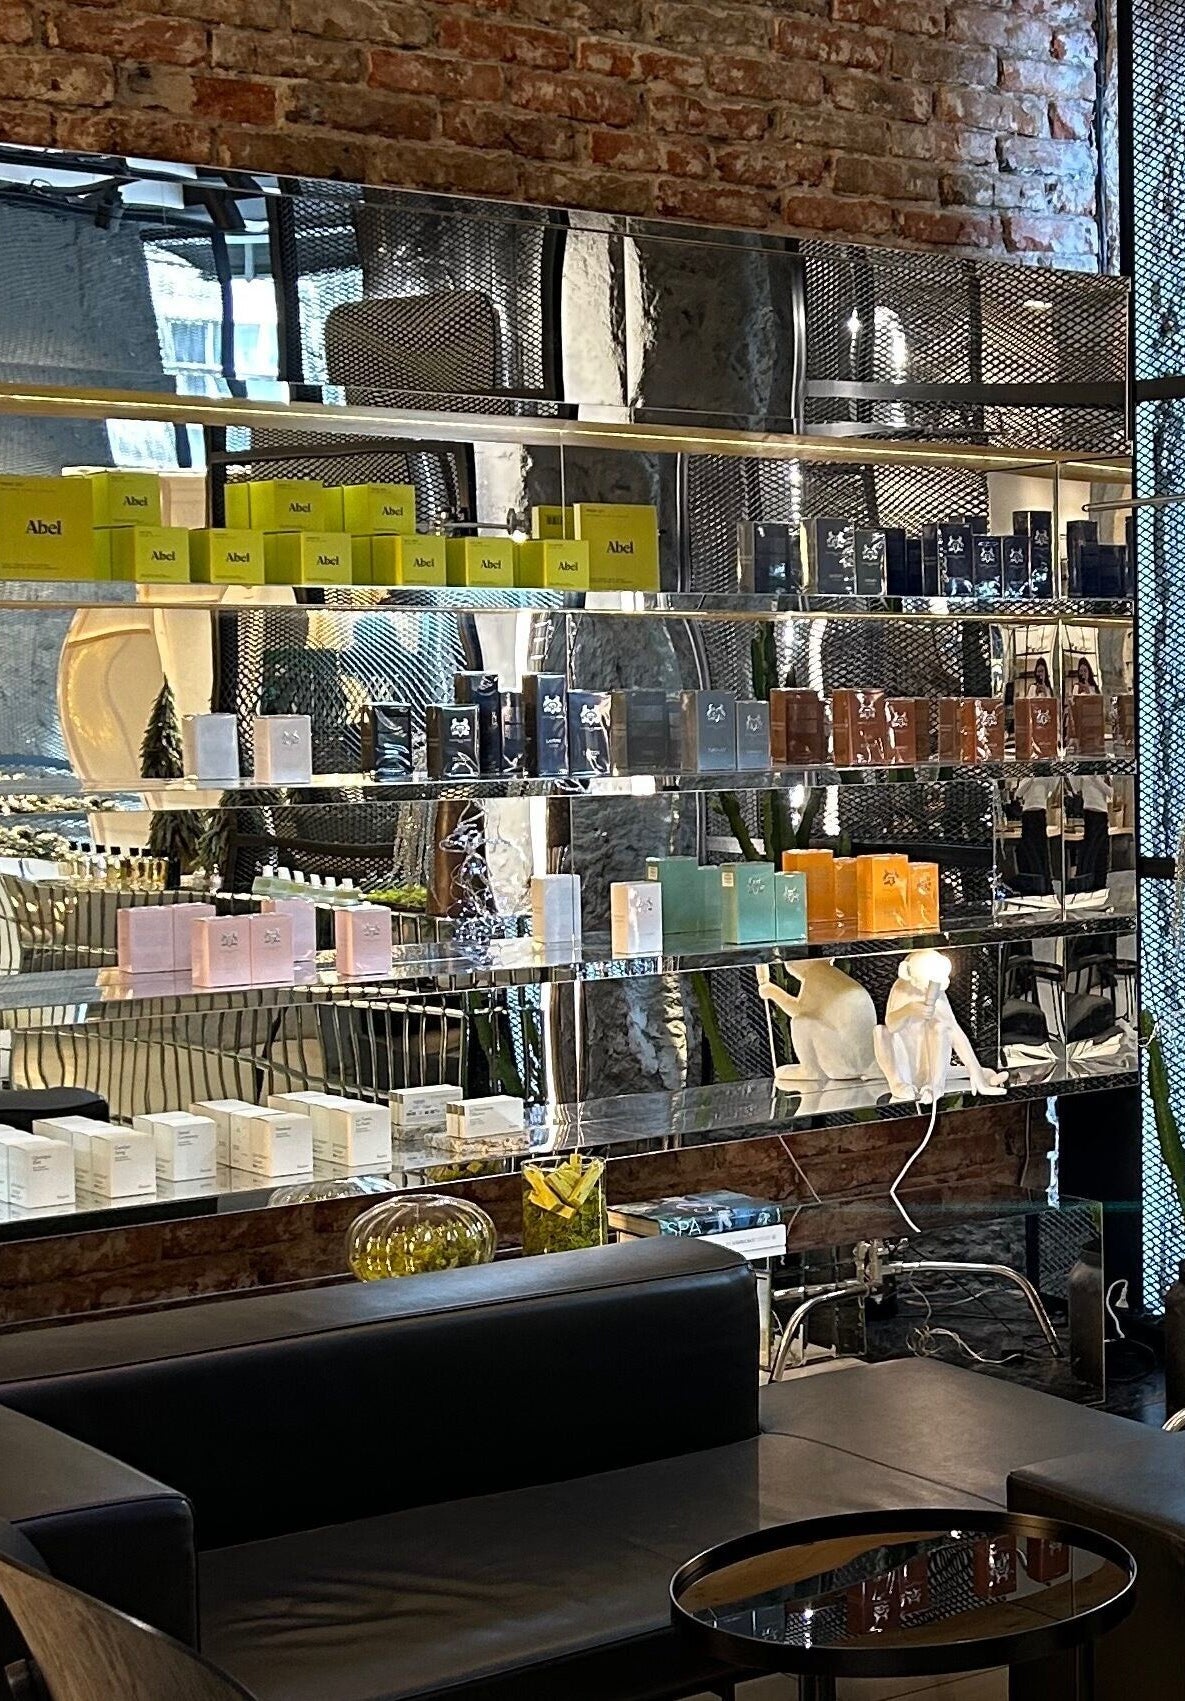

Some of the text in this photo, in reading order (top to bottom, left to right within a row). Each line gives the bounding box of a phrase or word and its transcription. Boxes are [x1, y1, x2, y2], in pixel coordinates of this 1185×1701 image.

[122, 495, 149, 507] Abel
[288, 502, 311, 513] Abel
[381, 506, 404, 516] Abel
[26, 519, 62, 535] Abel
[606, 540, 634, 554] Abel
[151, 550, 176, 562] Abel
[226, 552, 250, 563] Abel
[317, 555, 339, 566] Abel
[413, 557, 435, 568] Abel
[481, 559, 502, 570] Abel
[558, 561, 579, 572] Abel
